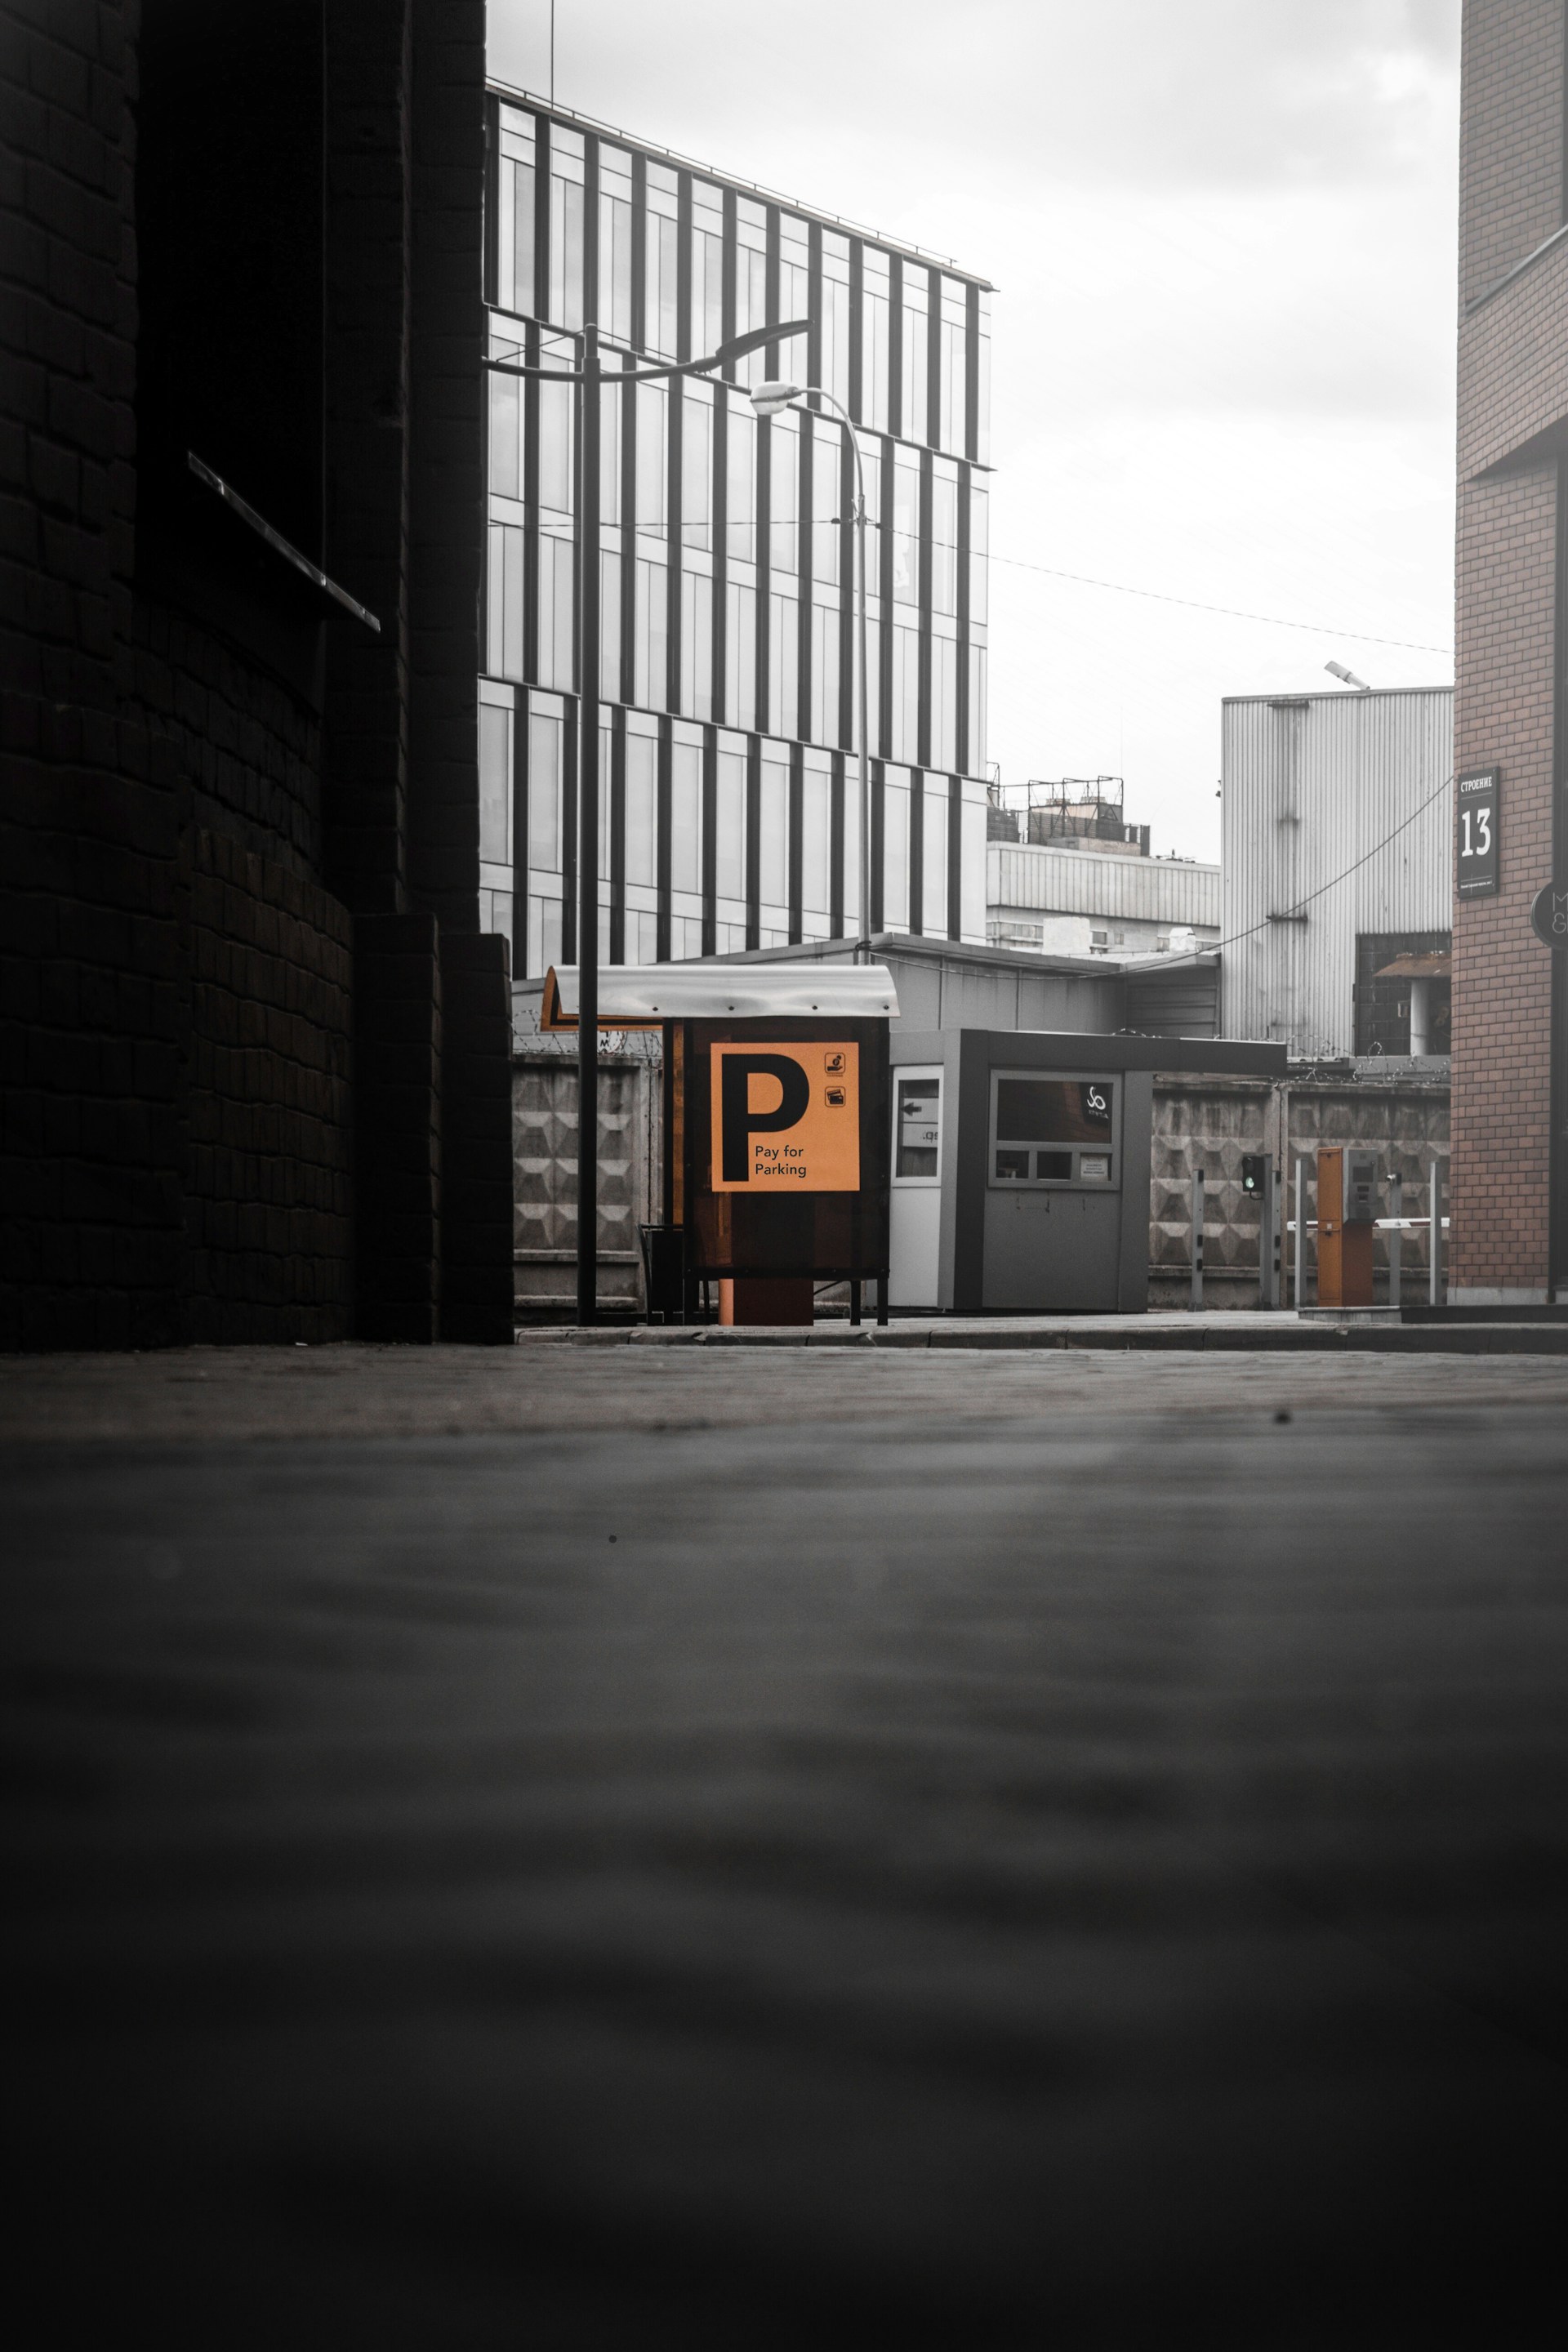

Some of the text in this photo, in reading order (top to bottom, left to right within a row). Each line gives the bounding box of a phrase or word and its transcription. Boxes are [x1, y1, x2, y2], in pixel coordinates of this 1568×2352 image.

[1460, 776, 1493, 793] СТРОЕНИЕ
[1461, 807, 1491, 858] 13
[721, 1053, 810, 1183] P
[755, 1144, 804, 1160] Pay for
[755, 1162, 807, 1178] Parking
